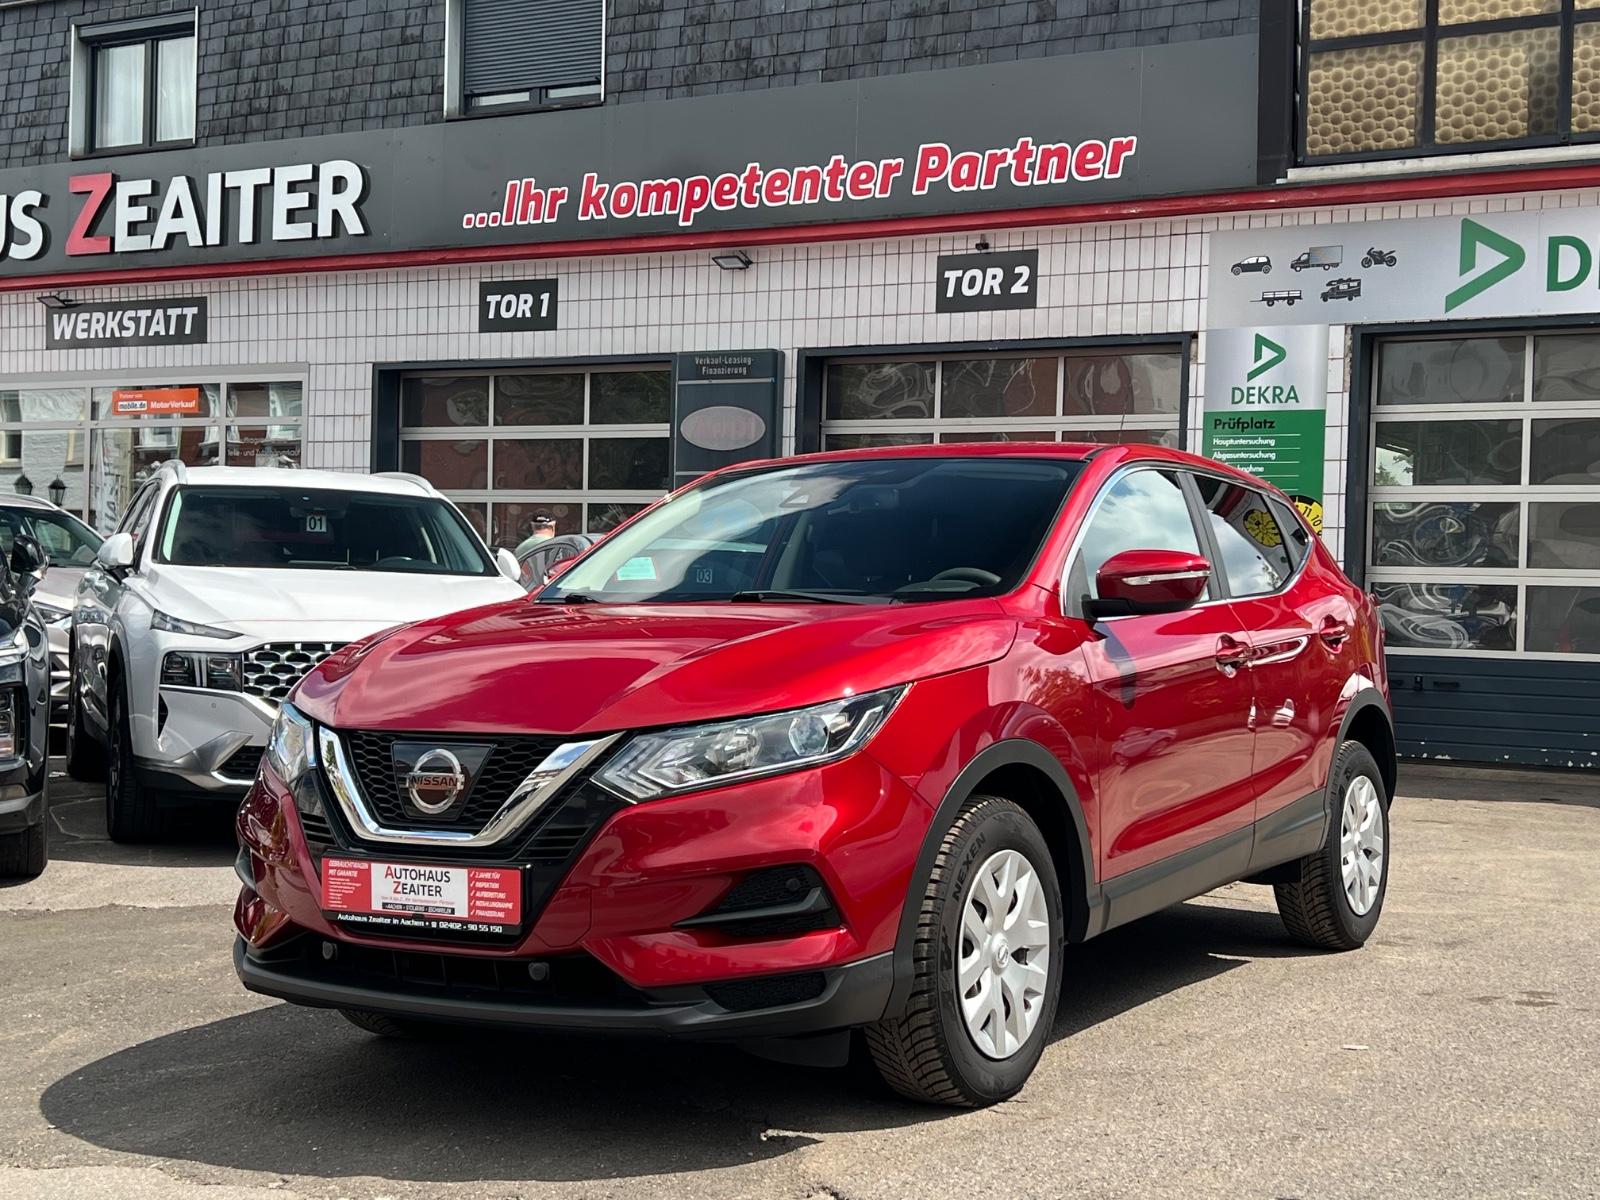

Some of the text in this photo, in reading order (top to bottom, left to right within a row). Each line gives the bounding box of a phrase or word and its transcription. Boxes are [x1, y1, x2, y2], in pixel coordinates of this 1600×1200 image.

[578, 155, 904, 227] kompetenter
[911, 136, 1137, 196] Partner
[65, 159, 367, 256] ZEAITER
[1546, 235, 1600, 292] D
[944, 265, 1030, 298] TOR 2
[486, 292, 550, 319] TOR 1
[52, 306, 199, 341] WERKSTATT
[702, 366, 747, 375] Finanzierung
[1231, 385, 1300, 405] DEKRA
[119, 402, 146, 410] mobile.de
[1213, 417, 1276, 432] Prüfplatz
[1212, 437, 1276, 447] Hauptuntersuchung
[1212, 450, 1277, 461] Abgasuntersuchung
[1302, 506, 1313, 518] 11
[1311, 514, 1322, 527] 10
[309, 516, 323, 530] 01
[410, 776, 458, 787] NISSAN
[384, 865, 451, 883] AUTOHAUS
[952, 832, 985, 902] NEXEN
[392, 881, 443, 897] ZEAITER
[337, 913, 367, 922] Autohaus
[400, 918, 424, 927] Aachen
[439, 921, 462, 930] 02402
[479, 924, 489, 932] 55
[490, 925, 503, 933] 150
